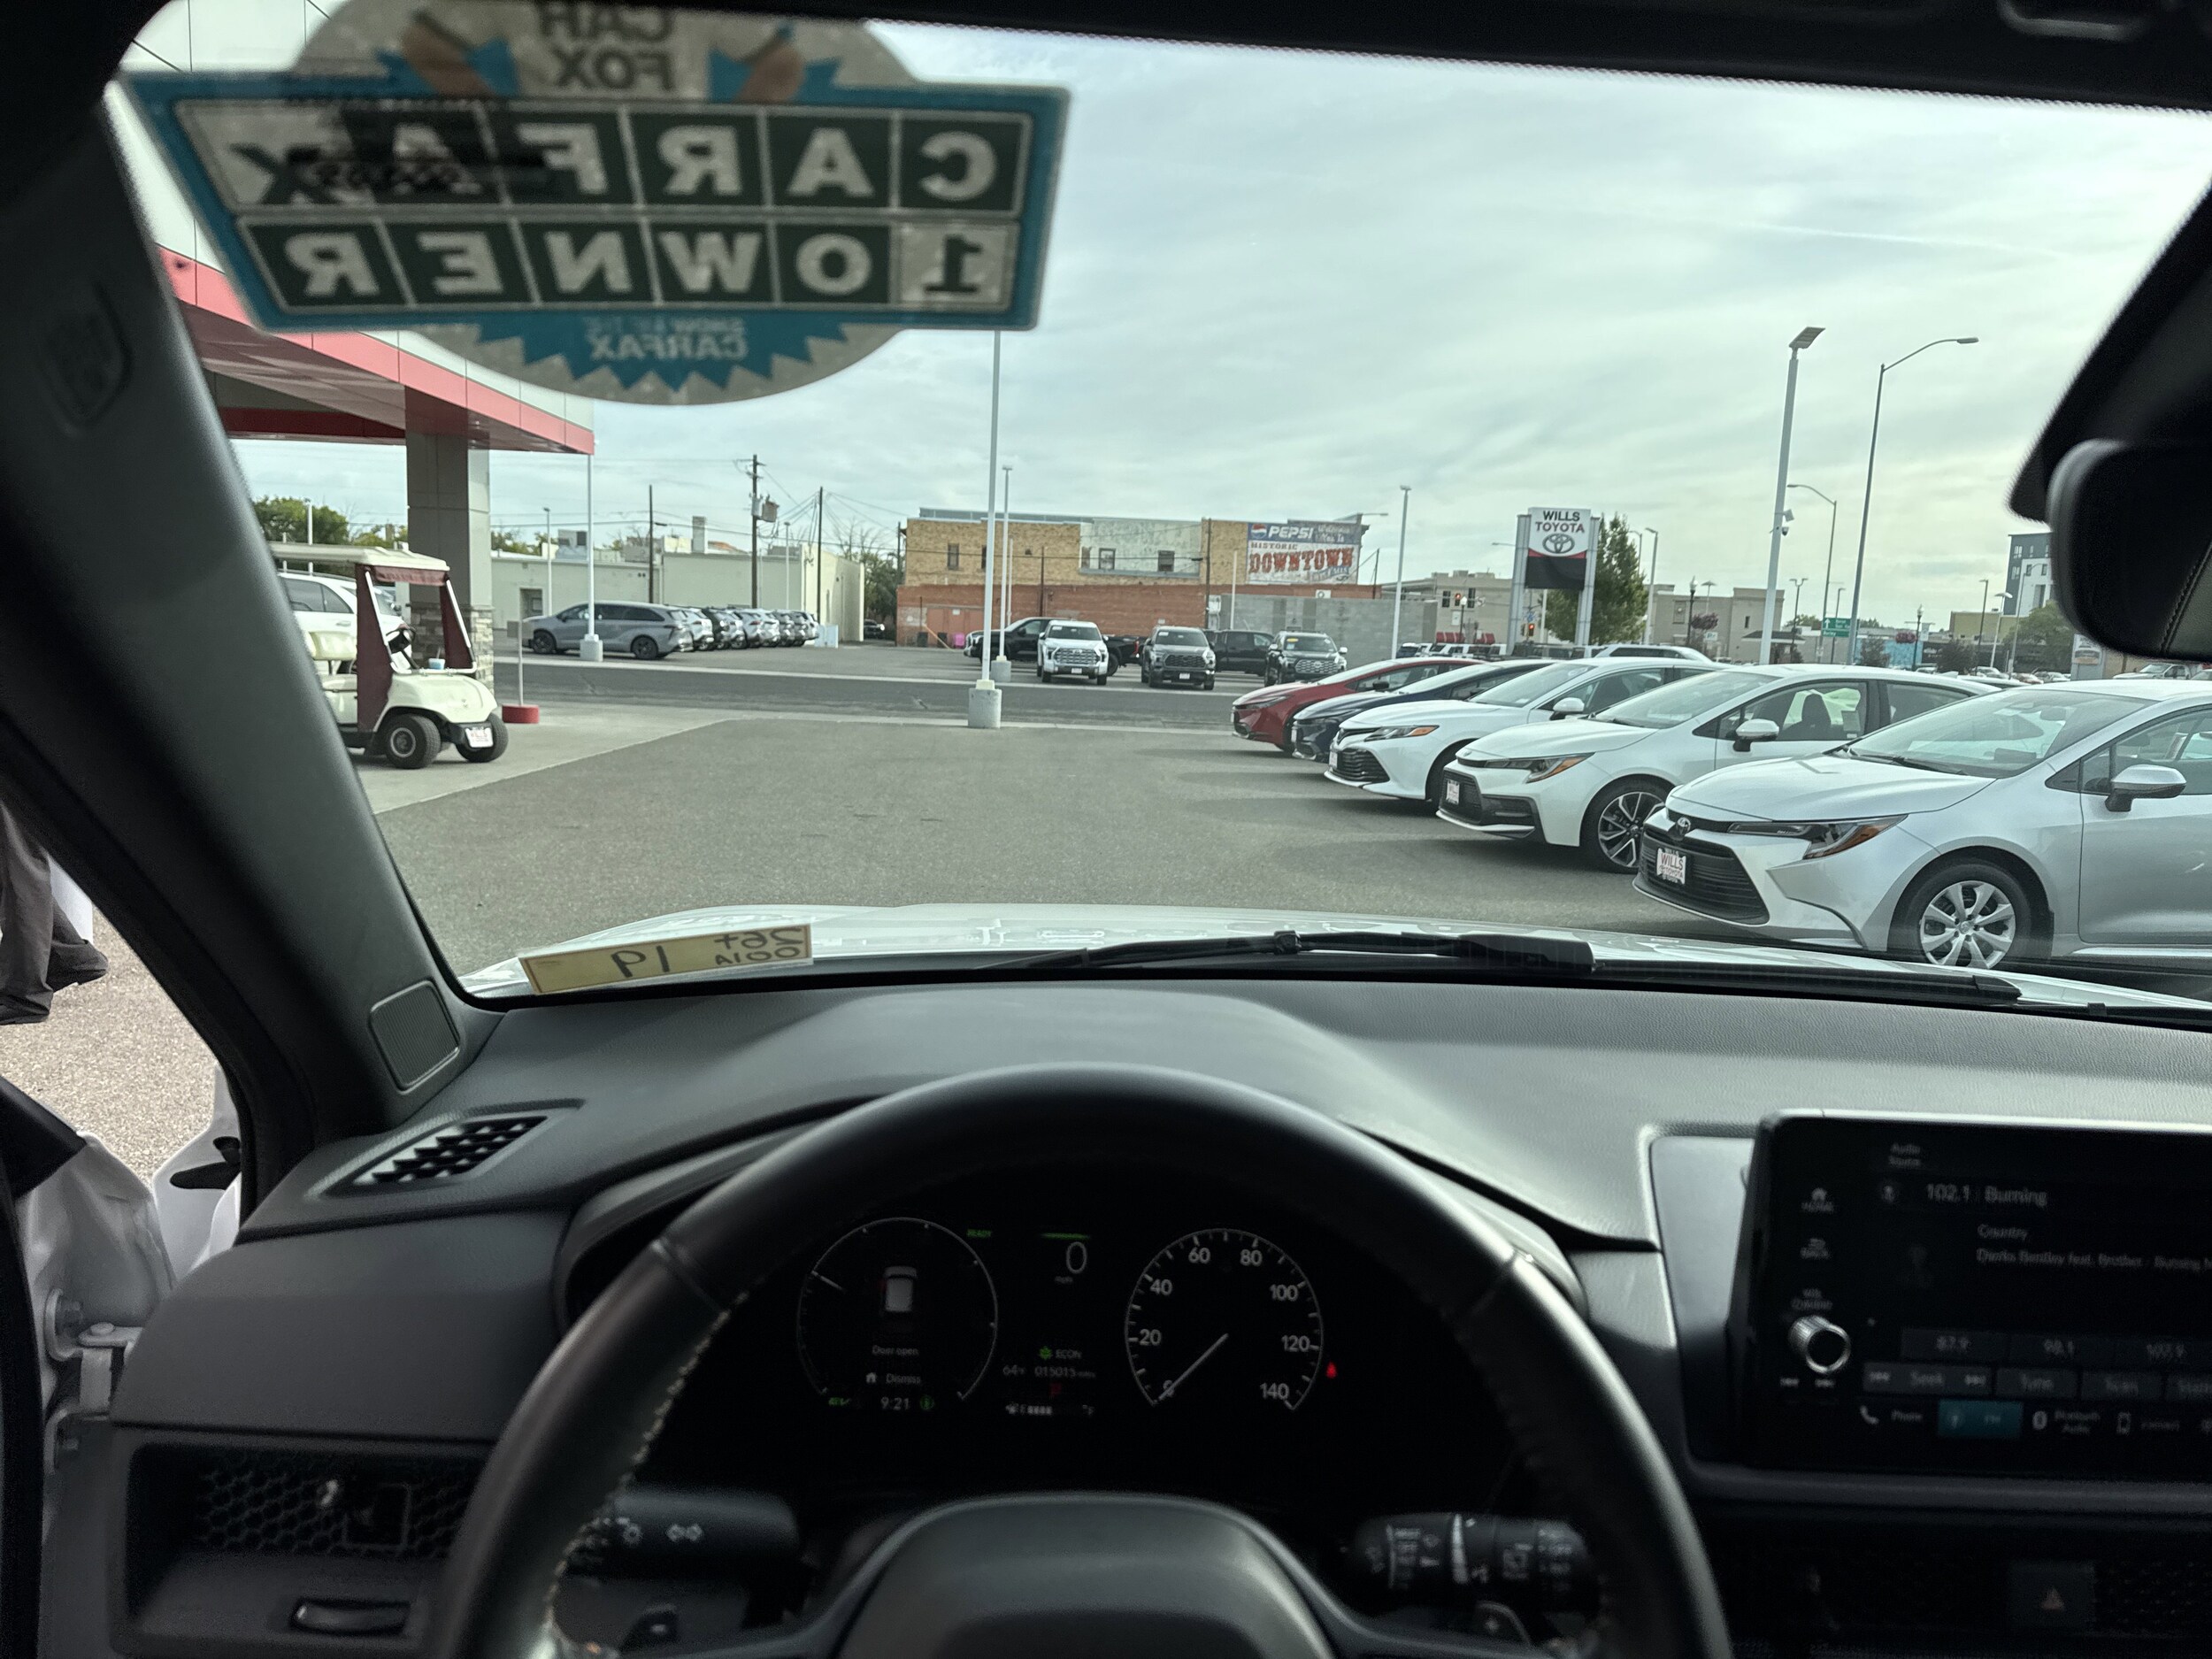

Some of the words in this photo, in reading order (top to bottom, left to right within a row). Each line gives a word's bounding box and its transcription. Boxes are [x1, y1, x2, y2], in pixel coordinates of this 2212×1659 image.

[1543, 510, 1580, 522] WILLS
[1268, 526, 1314, 539] PEPSI
[1535, 521, 1585, 533] TOYOTA
[1250, 541, 1298, 550] HISTORIC
[1248, 547, 1355, 574] DOWNTOWN
[1661, 852, 1684, 871] WILLS
[1985, 1186, 2048, 1209] Burning
[1066, 1241, 1087, 1274] 0
[1188, 1247, 1210, 1263] 60
[1240, 1248, 1263, 1266] 80
[1150, 1279, 1172, 1295] 40
[1270, 1284, 1298, 1301] 100
[1139, 1329, 1161, 1346] 20
[1281, 1334, 1310, 1352] 120
[1260, 1382, 1289, 1399] 140
[880, 1396, 910, 1410] 9:21
